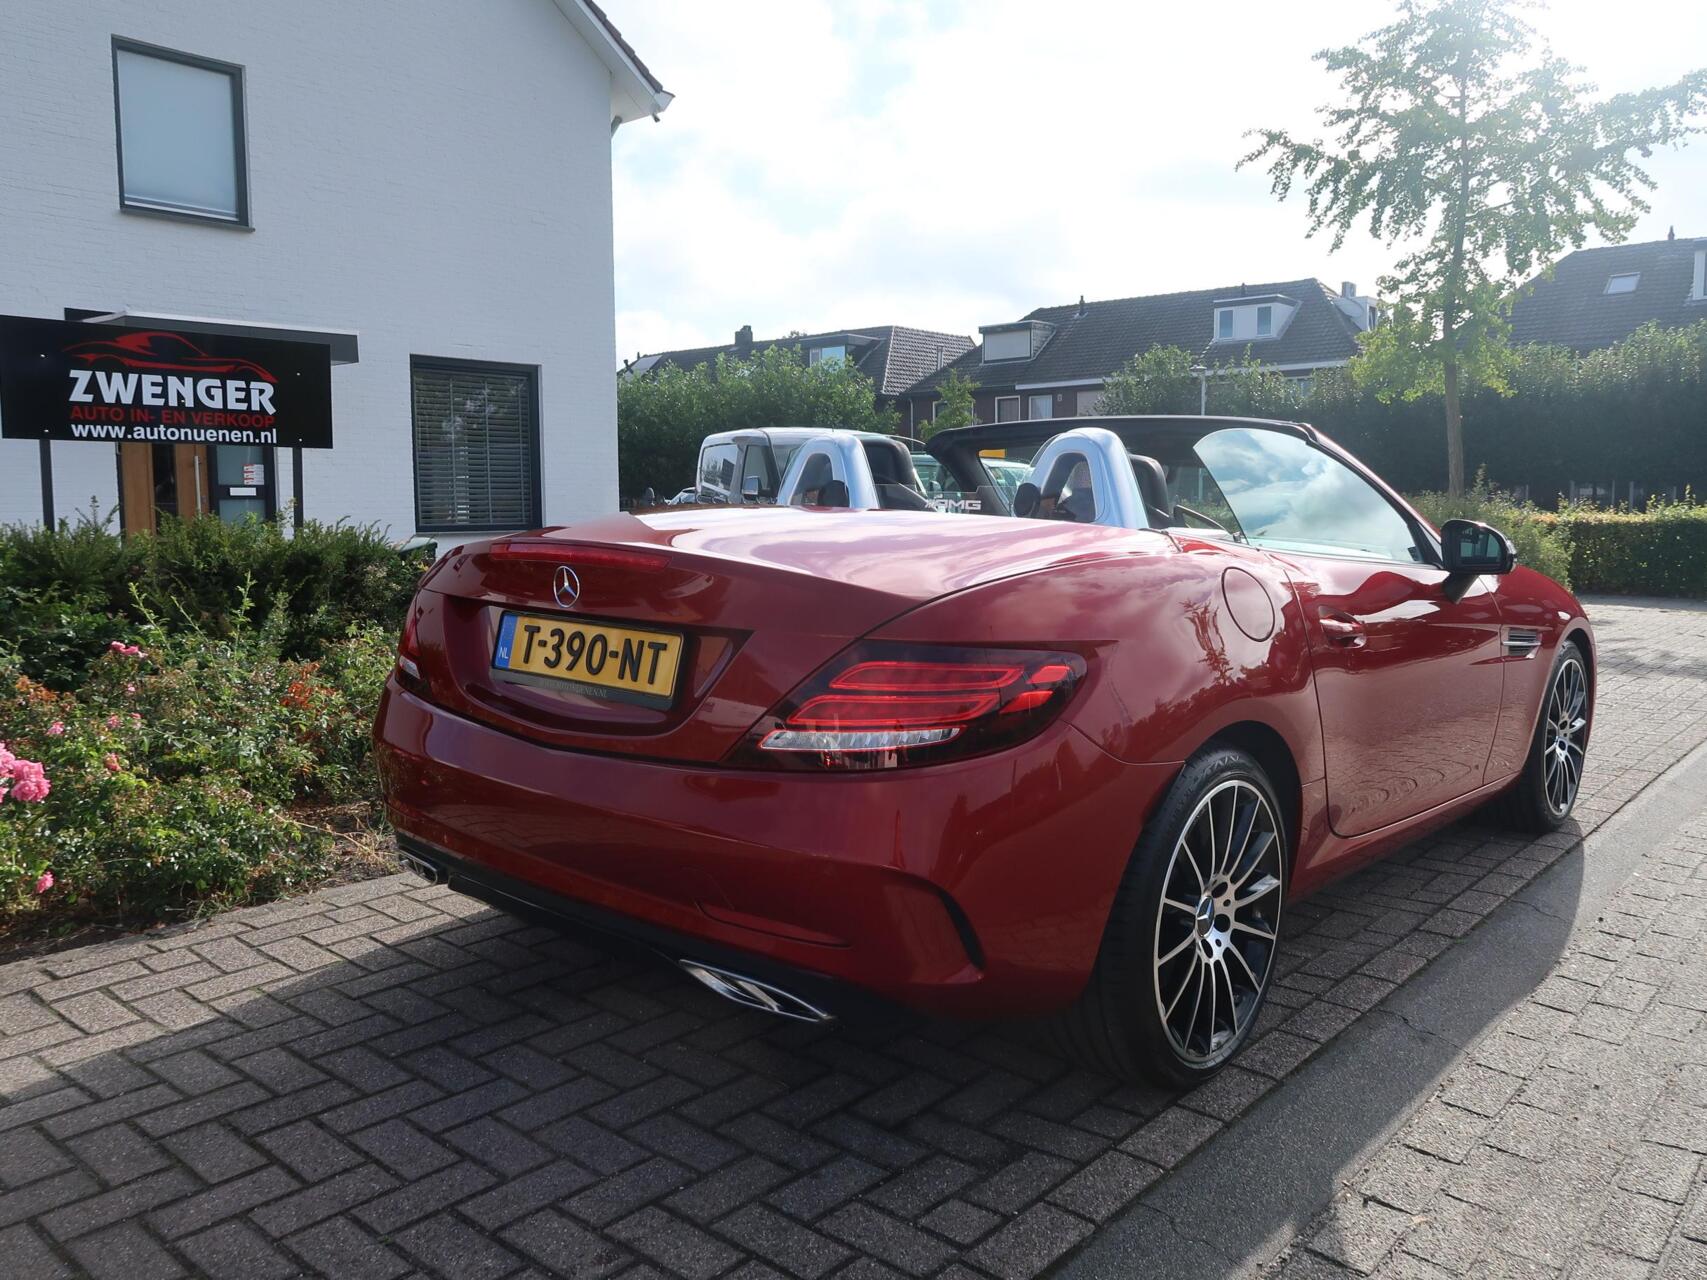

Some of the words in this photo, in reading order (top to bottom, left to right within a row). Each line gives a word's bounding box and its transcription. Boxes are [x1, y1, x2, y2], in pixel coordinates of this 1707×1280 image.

[68, 369, 277, 415] ZWENGER
[70, 405, 125, 421] AUTO
[130, 408, 155, 423] IN-
[162, 410, 185, 424] EN
[192, 411, 275, 428] VERKOOP
[71, 424, 277, 444] www.autonuenen.nl
[934, 499, 982, 510] AMG
[499, 646, 509, 660] NL
[523, 624, 668, 685] T-390-NT
